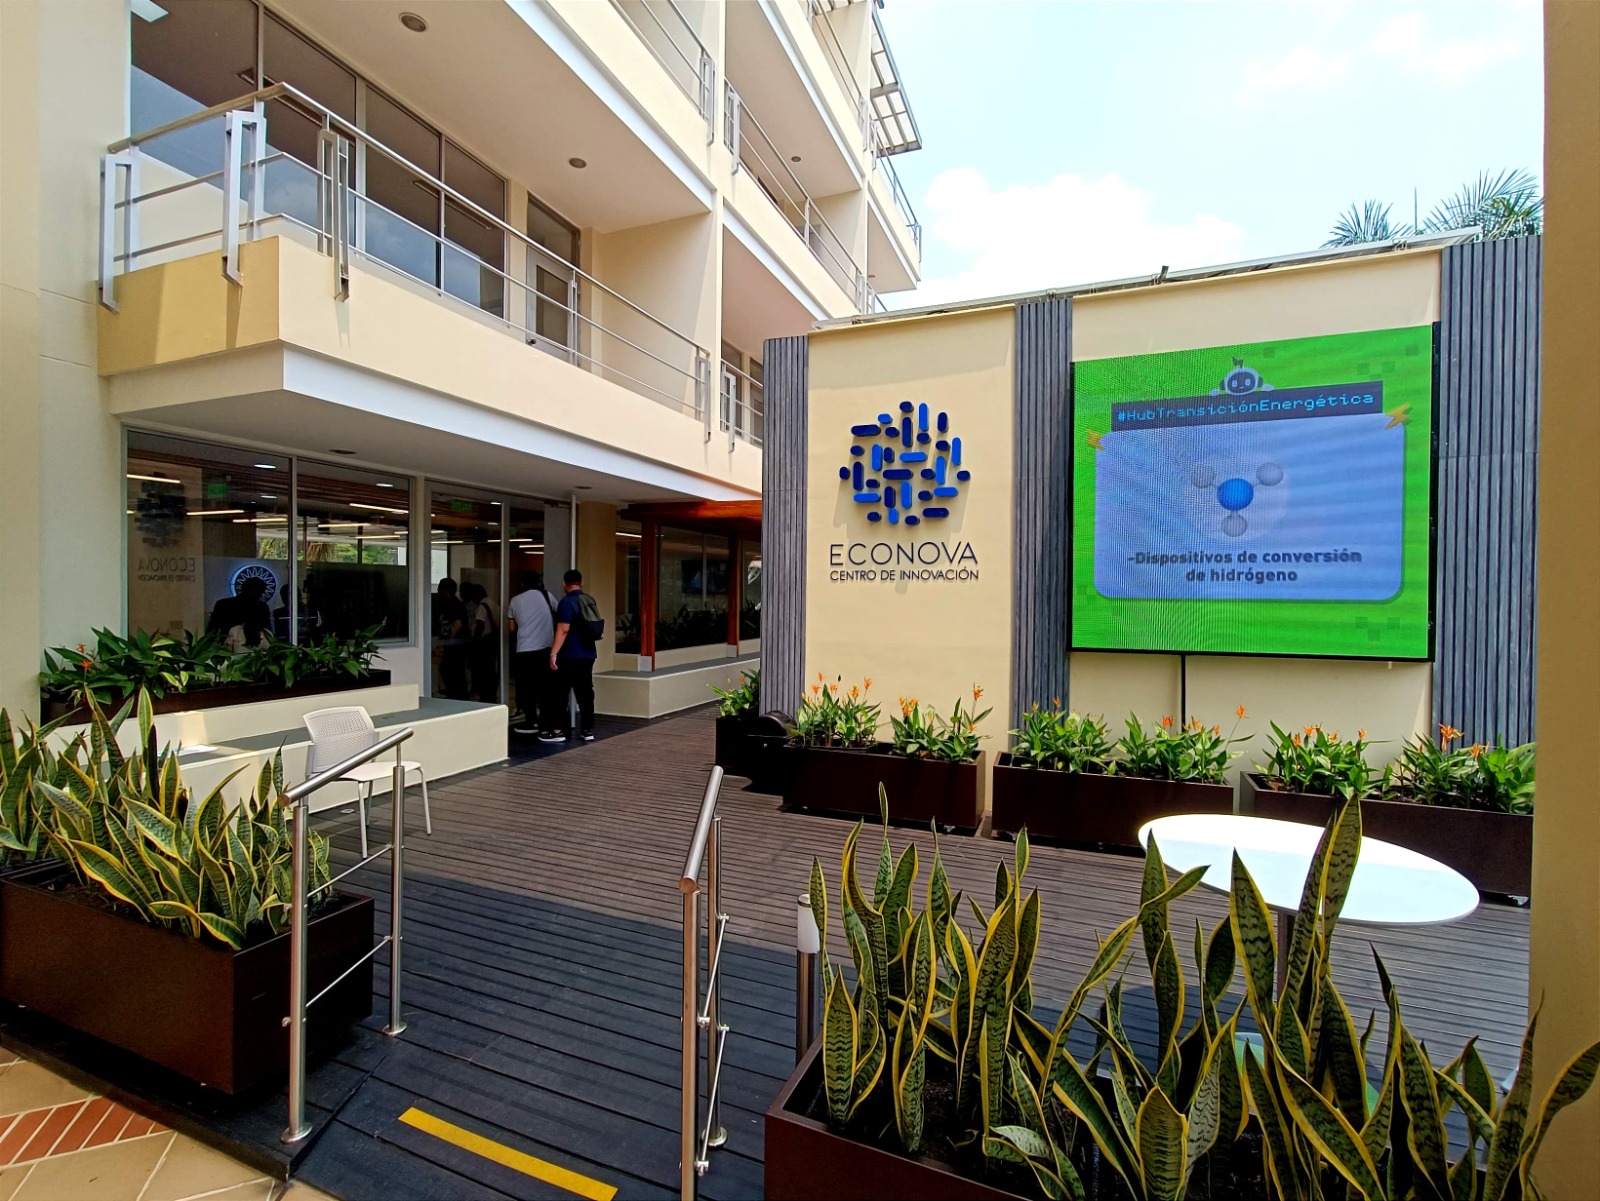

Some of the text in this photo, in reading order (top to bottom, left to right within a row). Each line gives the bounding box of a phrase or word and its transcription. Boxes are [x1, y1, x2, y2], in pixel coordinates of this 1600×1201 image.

[1117, 393, 1375, 422] #HubTransiciónEnergética
[830, 541, 978, 566] ECONOVA
[1237, 550, 1257, 563] de
[1262, 548, 1362, 563] conversión
[830, 567, 979, 581] CENTRO DE INNOVACIÓN
[1186, 567, 1298, 584] de hidrógeno
